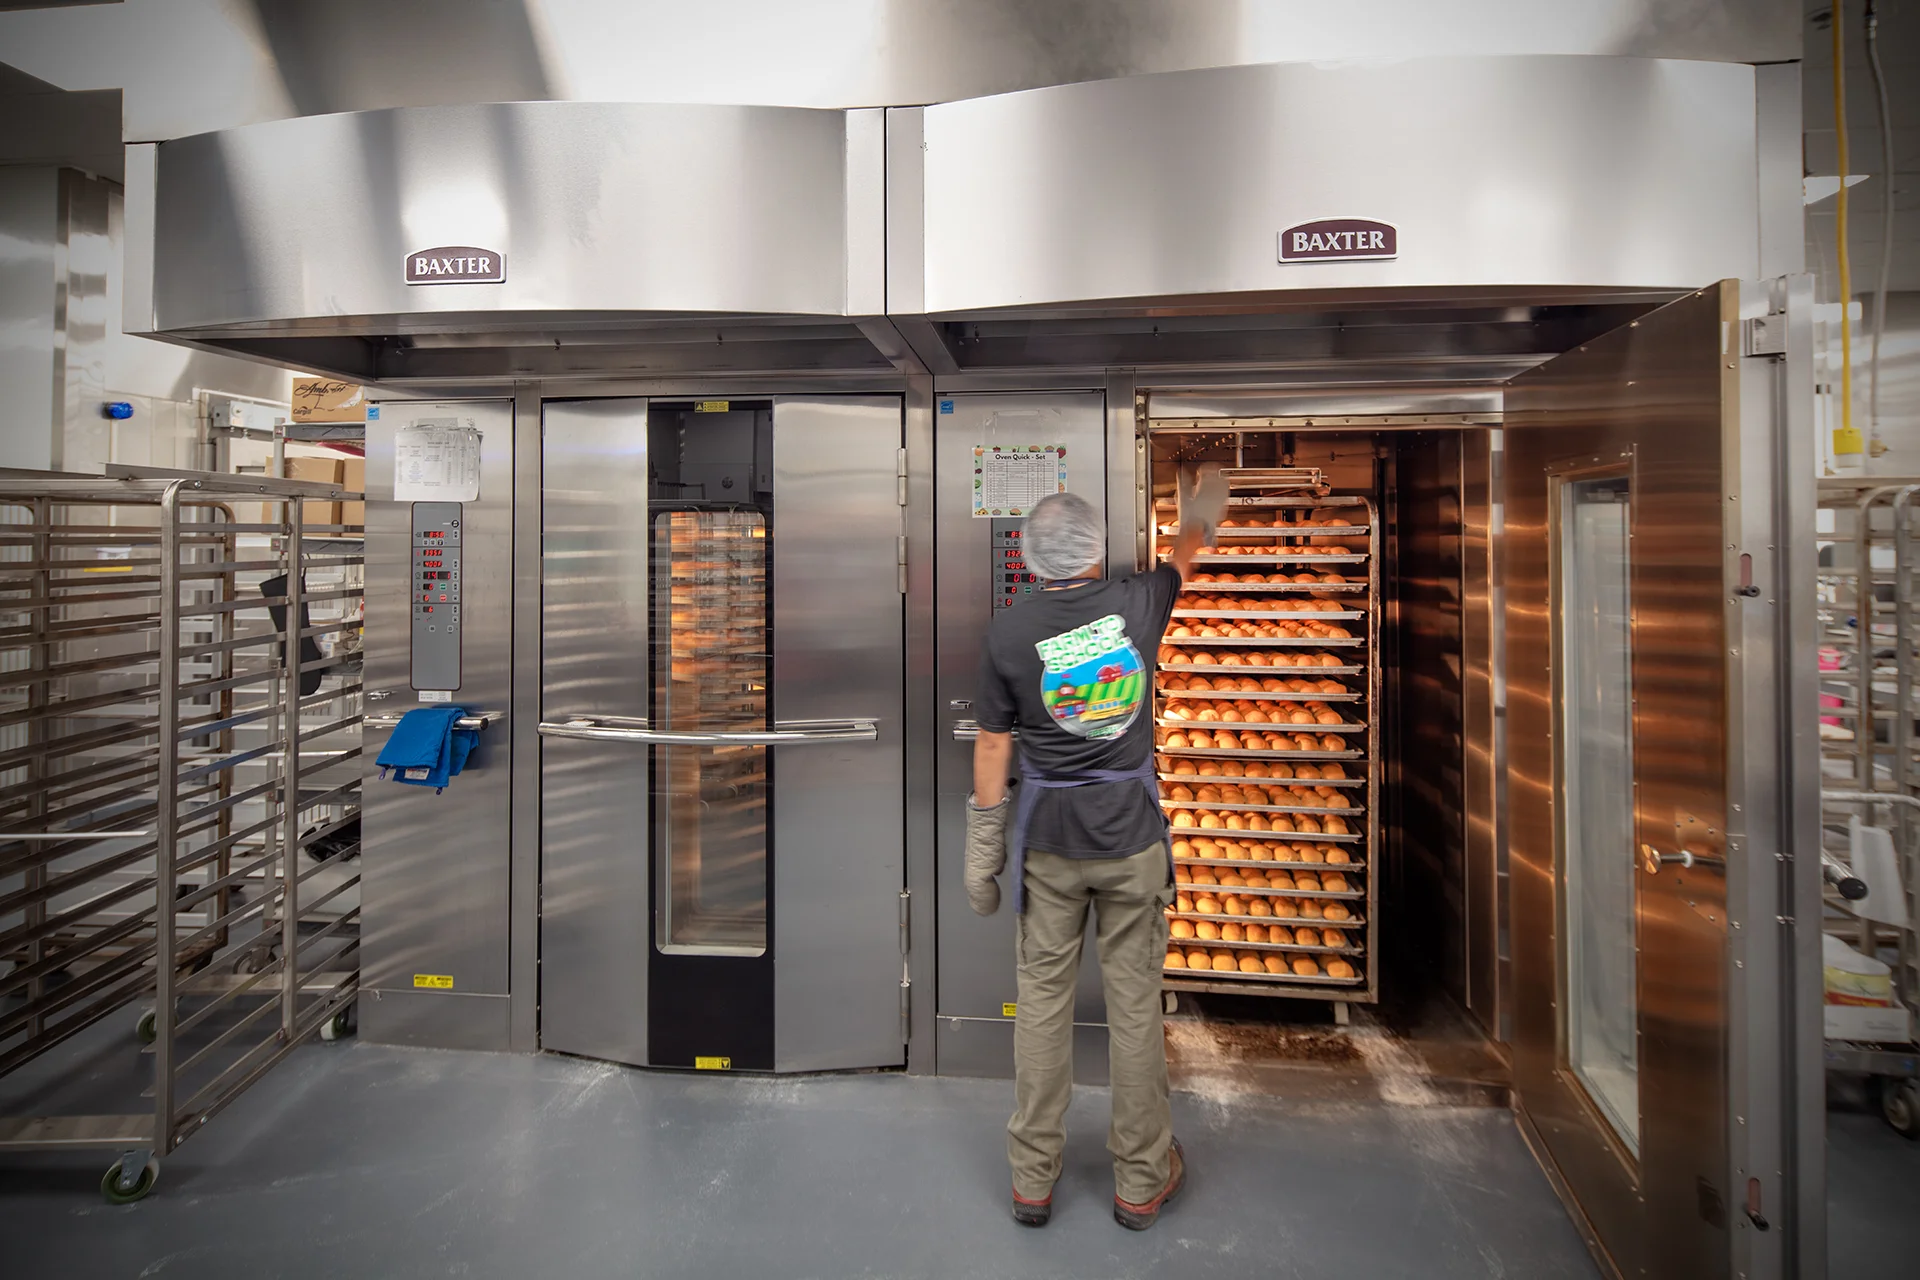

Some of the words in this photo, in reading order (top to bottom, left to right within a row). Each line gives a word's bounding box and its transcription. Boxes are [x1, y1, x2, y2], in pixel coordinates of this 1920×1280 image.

[1292, 231, 1386, 252] BAXTER
[415, 257, 491, 276] BAXTER
[1012, 453, 1031, 461] Quick
[1006, 562, 1026, 570] 400F
[1013, 573, 1020, 582] 0
[1029, 573, 1036, 582] 0
[1006, 598, 1012, 607] 0
[1039, 627, 1092, 659] FARM
[1090, 616, 1121, 635] TO
[1045, 635, 1127, 672] SCHOOL
